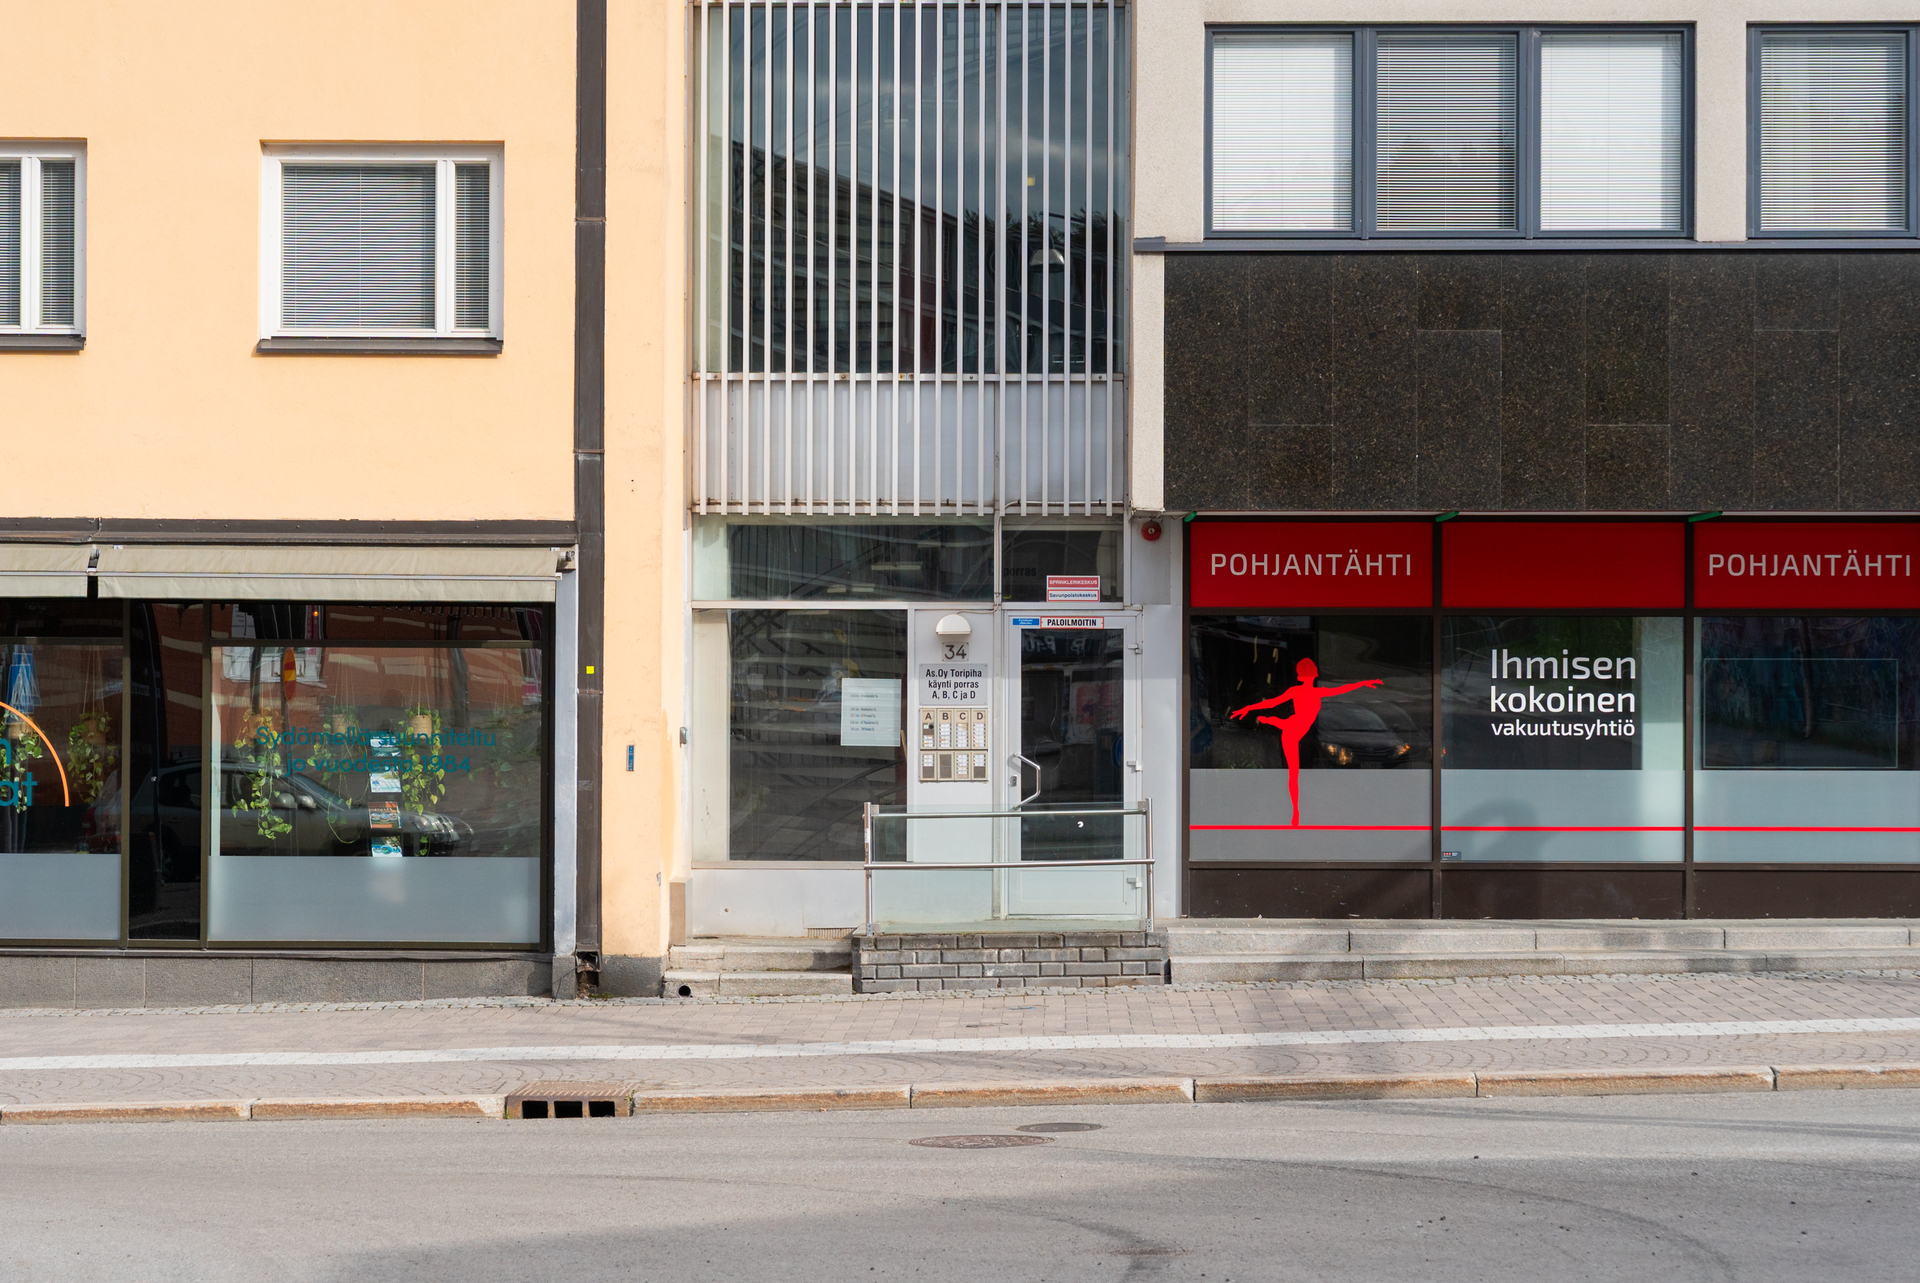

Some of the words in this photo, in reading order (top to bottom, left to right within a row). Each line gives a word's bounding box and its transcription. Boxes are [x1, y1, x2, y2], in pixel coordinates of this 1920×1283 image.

[1210, 548, 1411, 576] POHJANTÄHTI
[1708, 549, 1911, 577] POHJANTÄHTI
[1047, 618, 1097, 627] PALOILMOITIN
[944, 644, 967, 660] 34
[1491, 648, 1636, 680] Ihmisen
[925, 668, 948, 679] As.Oy
[950, 668, 982, 679] Toripiha
[928, 680, 952, 690] käynti
[953, 681, 979, 690] porras
[932, 690, 940, 700] A,
[942, 690, 950, 700] B,
[952, 690, 958, 699] C
[960, 690, 968, 700] ja
[970, 690, 976, 699] D
[1490, 685, 1636, 713] kokoinen
[924, 712, 932, 720] A
[942, 712, 949, 720] B
[959, 712, 966, 720] C
[976, 712, 984, 720] D
[1491, 718, 1636, 741] vakuutusyhtiö
[255, 725, 371, 751] Sydämellä
[378, 726, 496, 747] suunniteltu
[284, 753, 306, 778] jo
[313, 754, 413, 773] vuodesta
[420, 754, 471, 773] 1984
